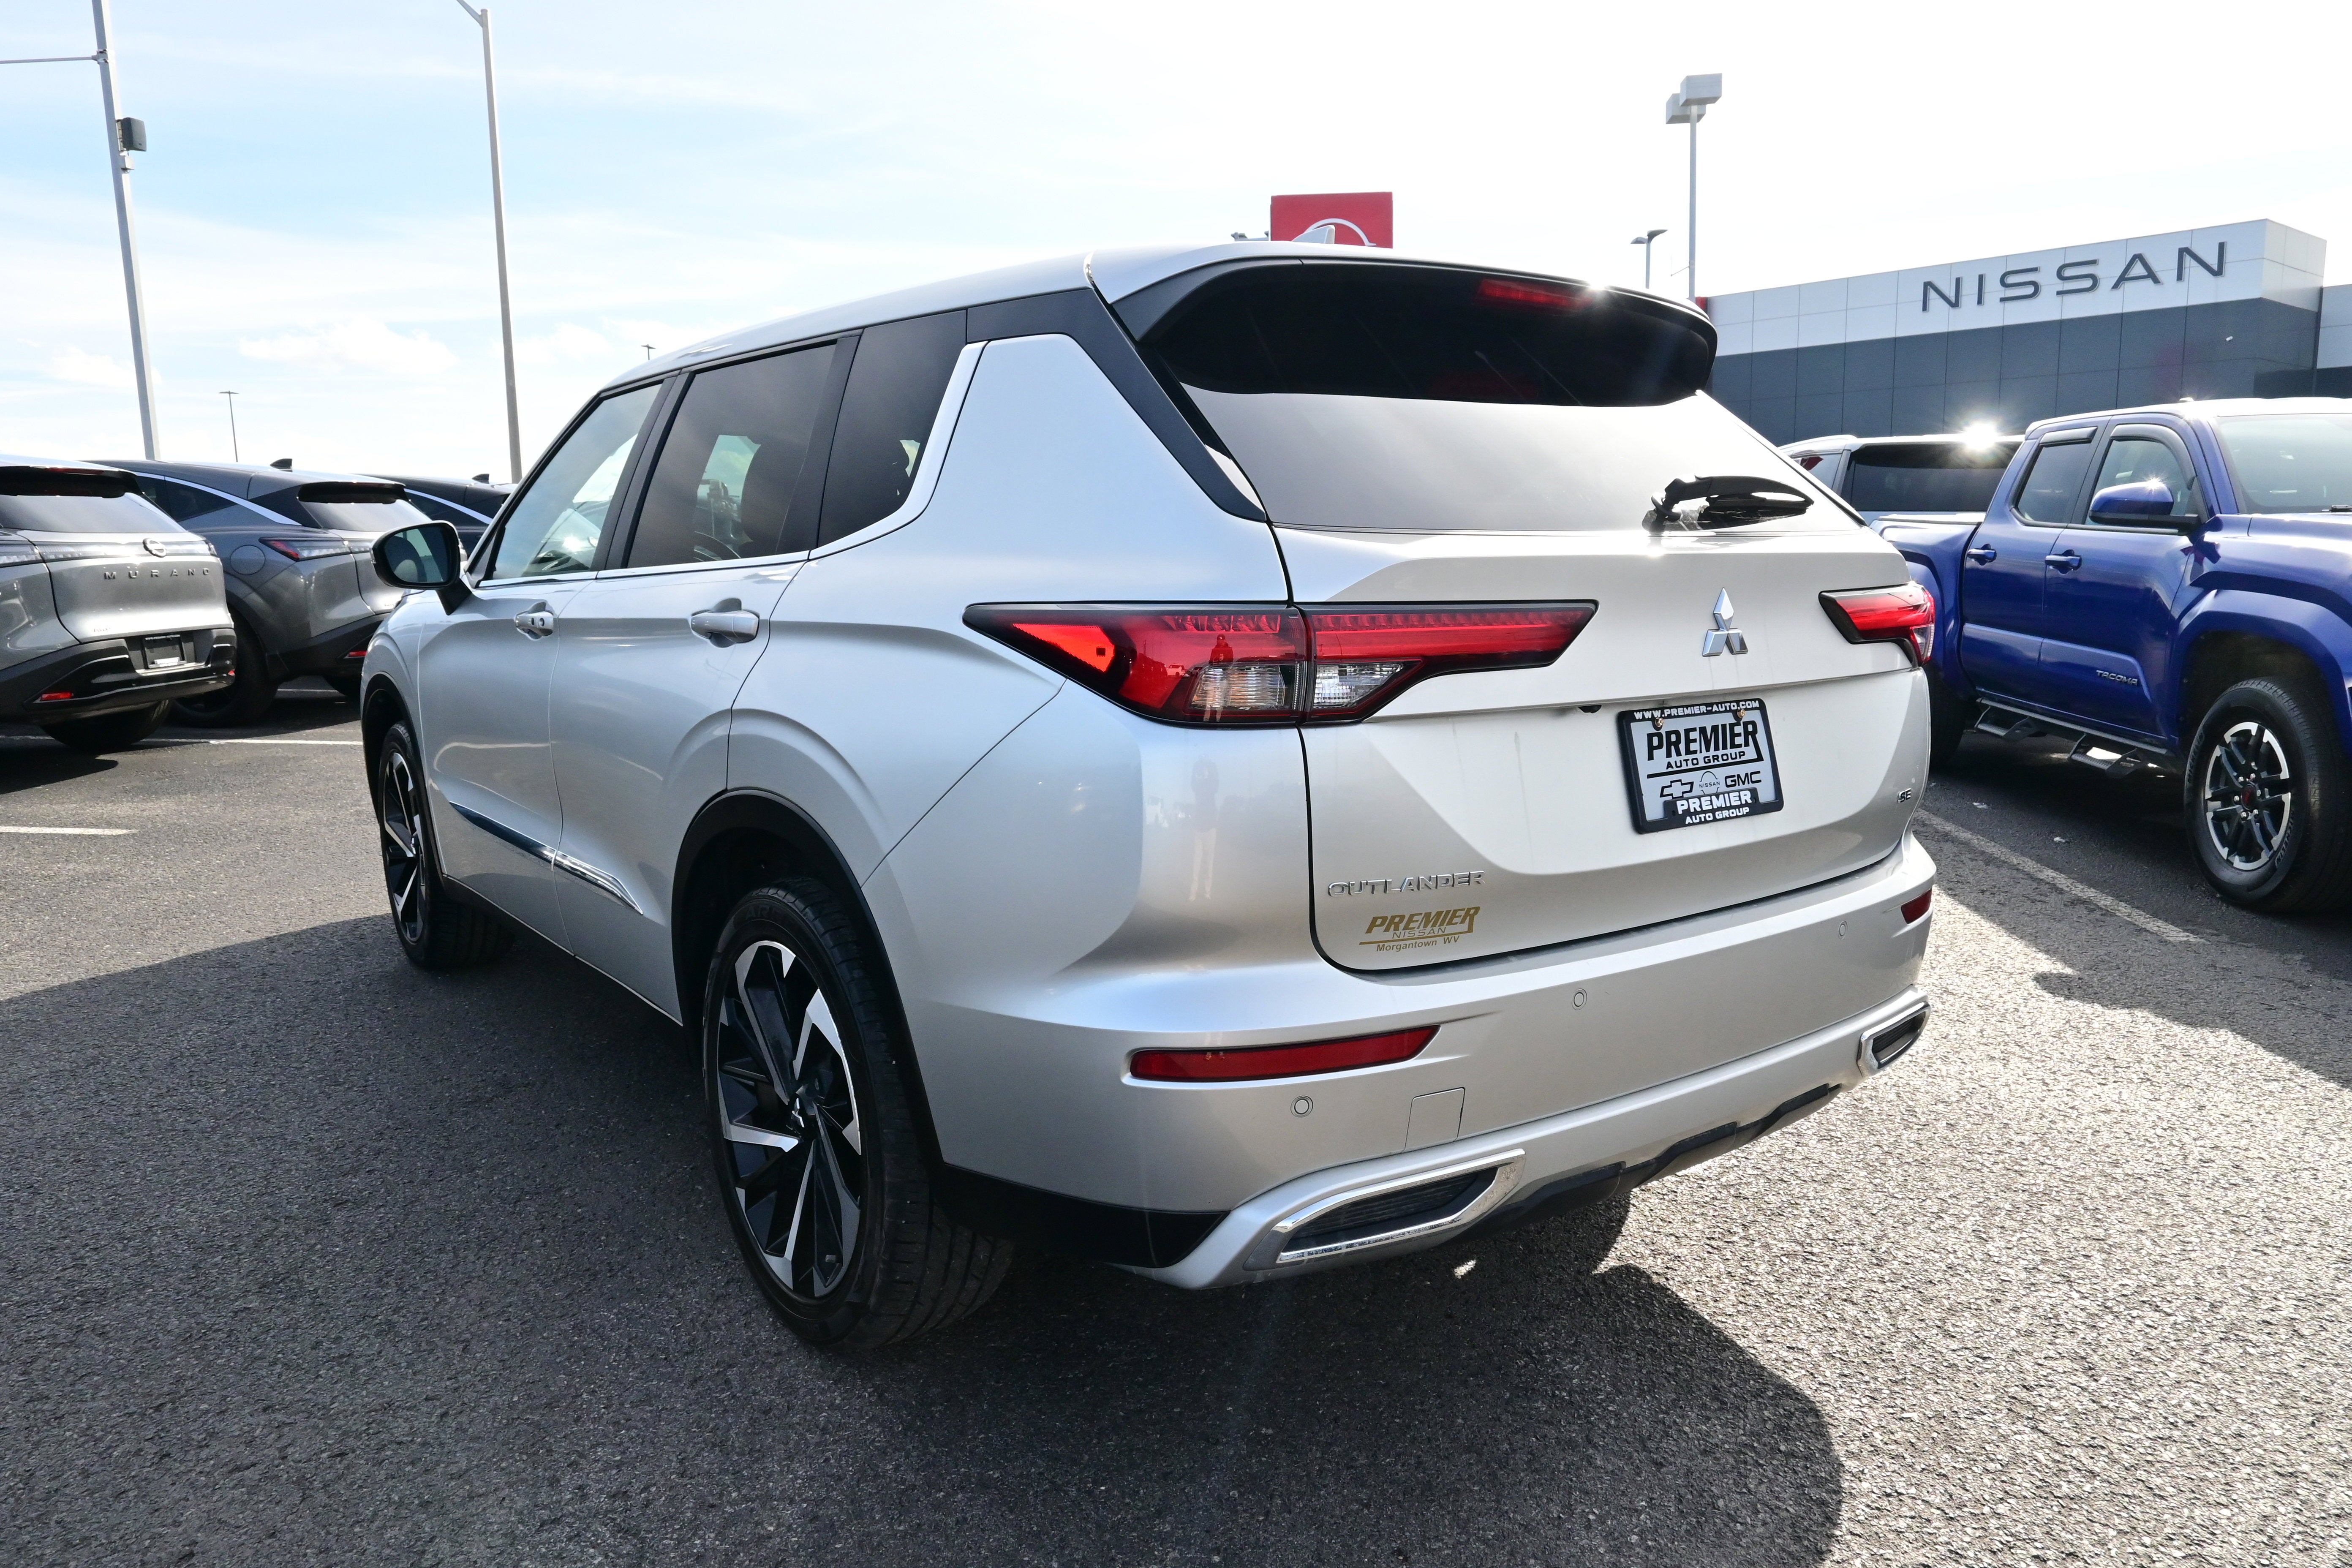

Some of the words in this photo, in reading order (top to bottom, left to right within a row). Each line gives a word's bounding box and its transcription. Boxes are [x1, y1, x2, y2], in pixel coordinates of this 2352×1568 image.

[1922, 241, 2227, 312] NISSAN
[104, 568, 210, 580] MURANO
[2096, 670, 2138, 686] TACOMA
[1634, 700, 1759, 719] WWW.PREMIER-AUTO.COM
[1647, 720, 1763, 761] PREMIER
[1666, 758, 1699, 769] AUTO
[1704, 751, 1745, 764] GROUP
[1725, 771, 1761, 788] GMC
[1676, 790, 1752, 814] PREMIER
[1897, 788, 1911, 803] SE
[1685, 813, 1713, 824] AUTO
[1715, 807, 1749, 819] GROUP
[1328, 870, 1486, 897] OUTLANDER
[1365, 906, 1481, 934] PREMIER
[1392, 927, 1446, 938] NISSAN
[1376, 940, 1437, 952] Morgantown
[1443, 935, 1460, 945] WV
